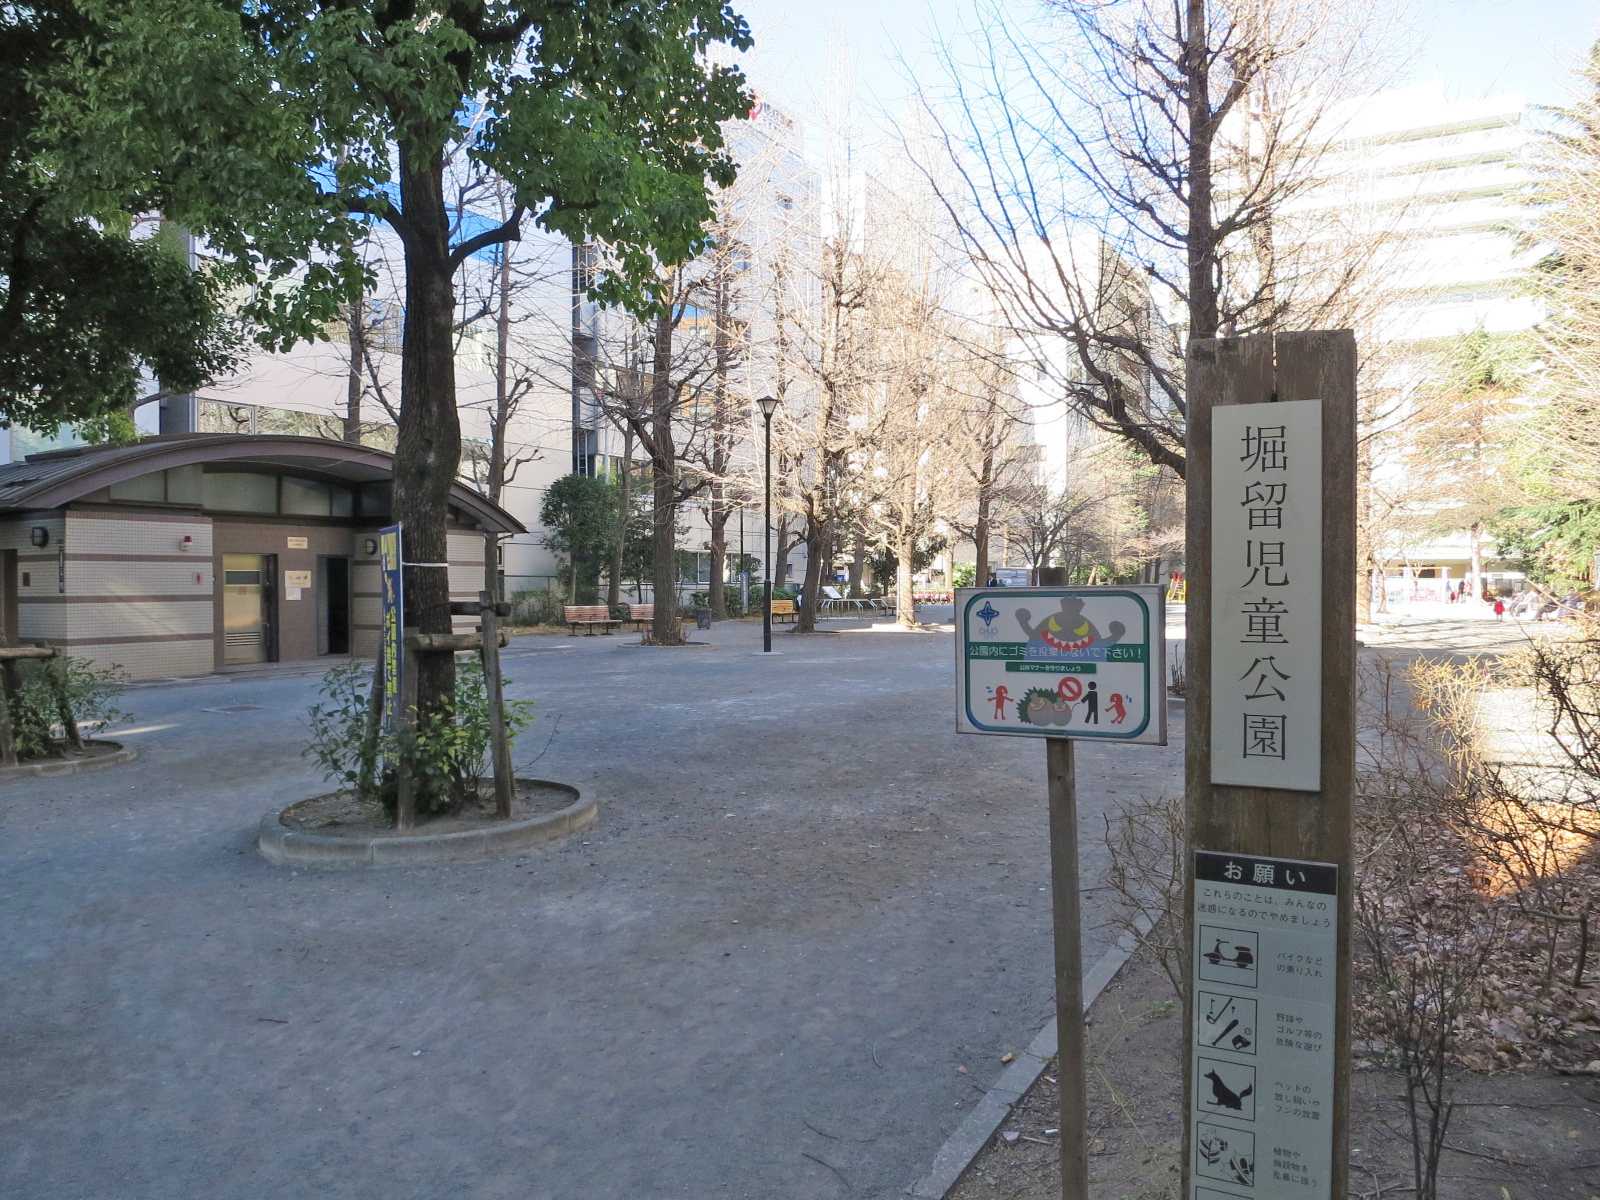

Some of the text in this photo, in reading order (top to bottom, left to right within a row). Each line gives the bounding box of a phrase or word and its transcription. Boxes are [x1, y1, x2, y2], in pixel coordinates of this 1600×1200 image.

[1239, 424, 1292, 761] 堀留児童公園
[1224, 861, 1306, 885] お願い
[1203, 888, 1327, 911] これらのことは、みんなの
[1197, 902, 1331, 928] 迷惑になるのでやめましょう
[1277, 952, 1322, 966] バイクなど
[1277, 964, 1322, 978] の乗り入れ
[1275, 1081, 1311, 1094] ペットの
